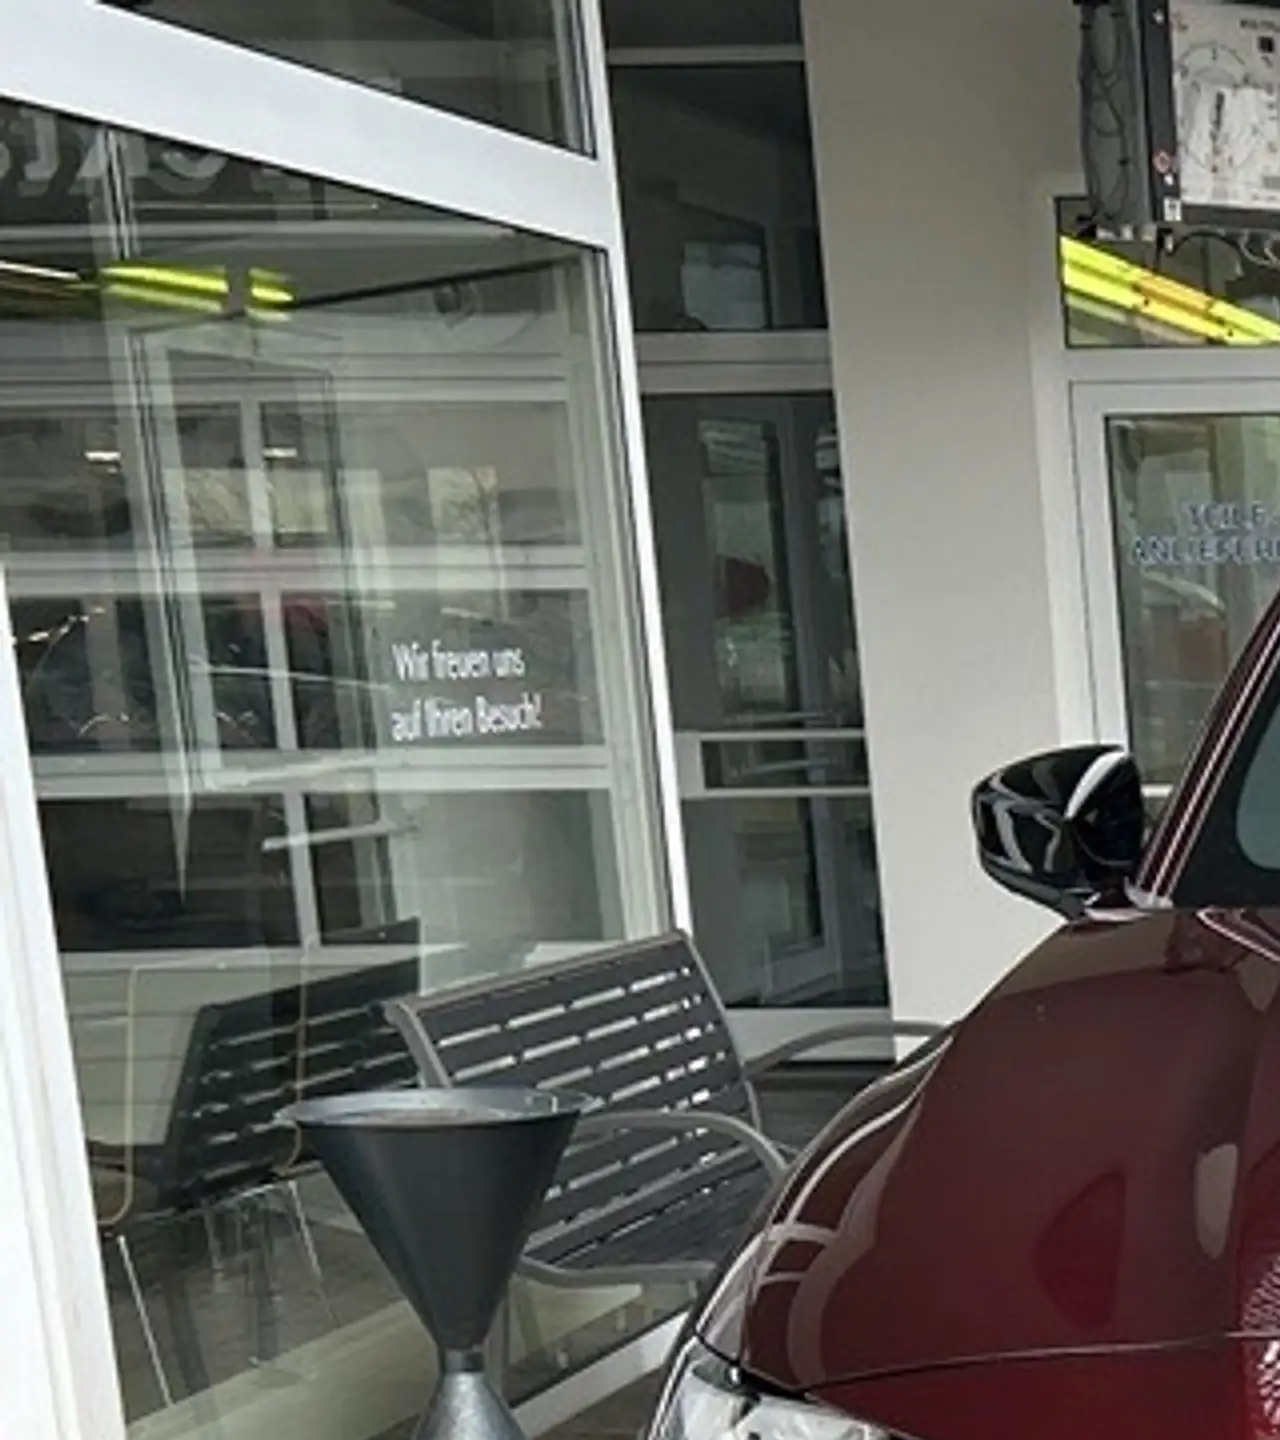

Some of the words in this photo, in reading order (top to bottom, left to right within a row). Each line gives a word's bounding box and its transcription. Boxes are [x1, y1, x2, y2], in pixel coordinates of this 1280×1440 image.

[391, 642, 430, 681] Wir
[431, 639, 490, 680] freuen
[492, 648, 526, 679] uns
[391, 698, 422, 742] auf
[423, 697, 474, 738] Ihren
[475, 691, 543, 734] Besuch!
